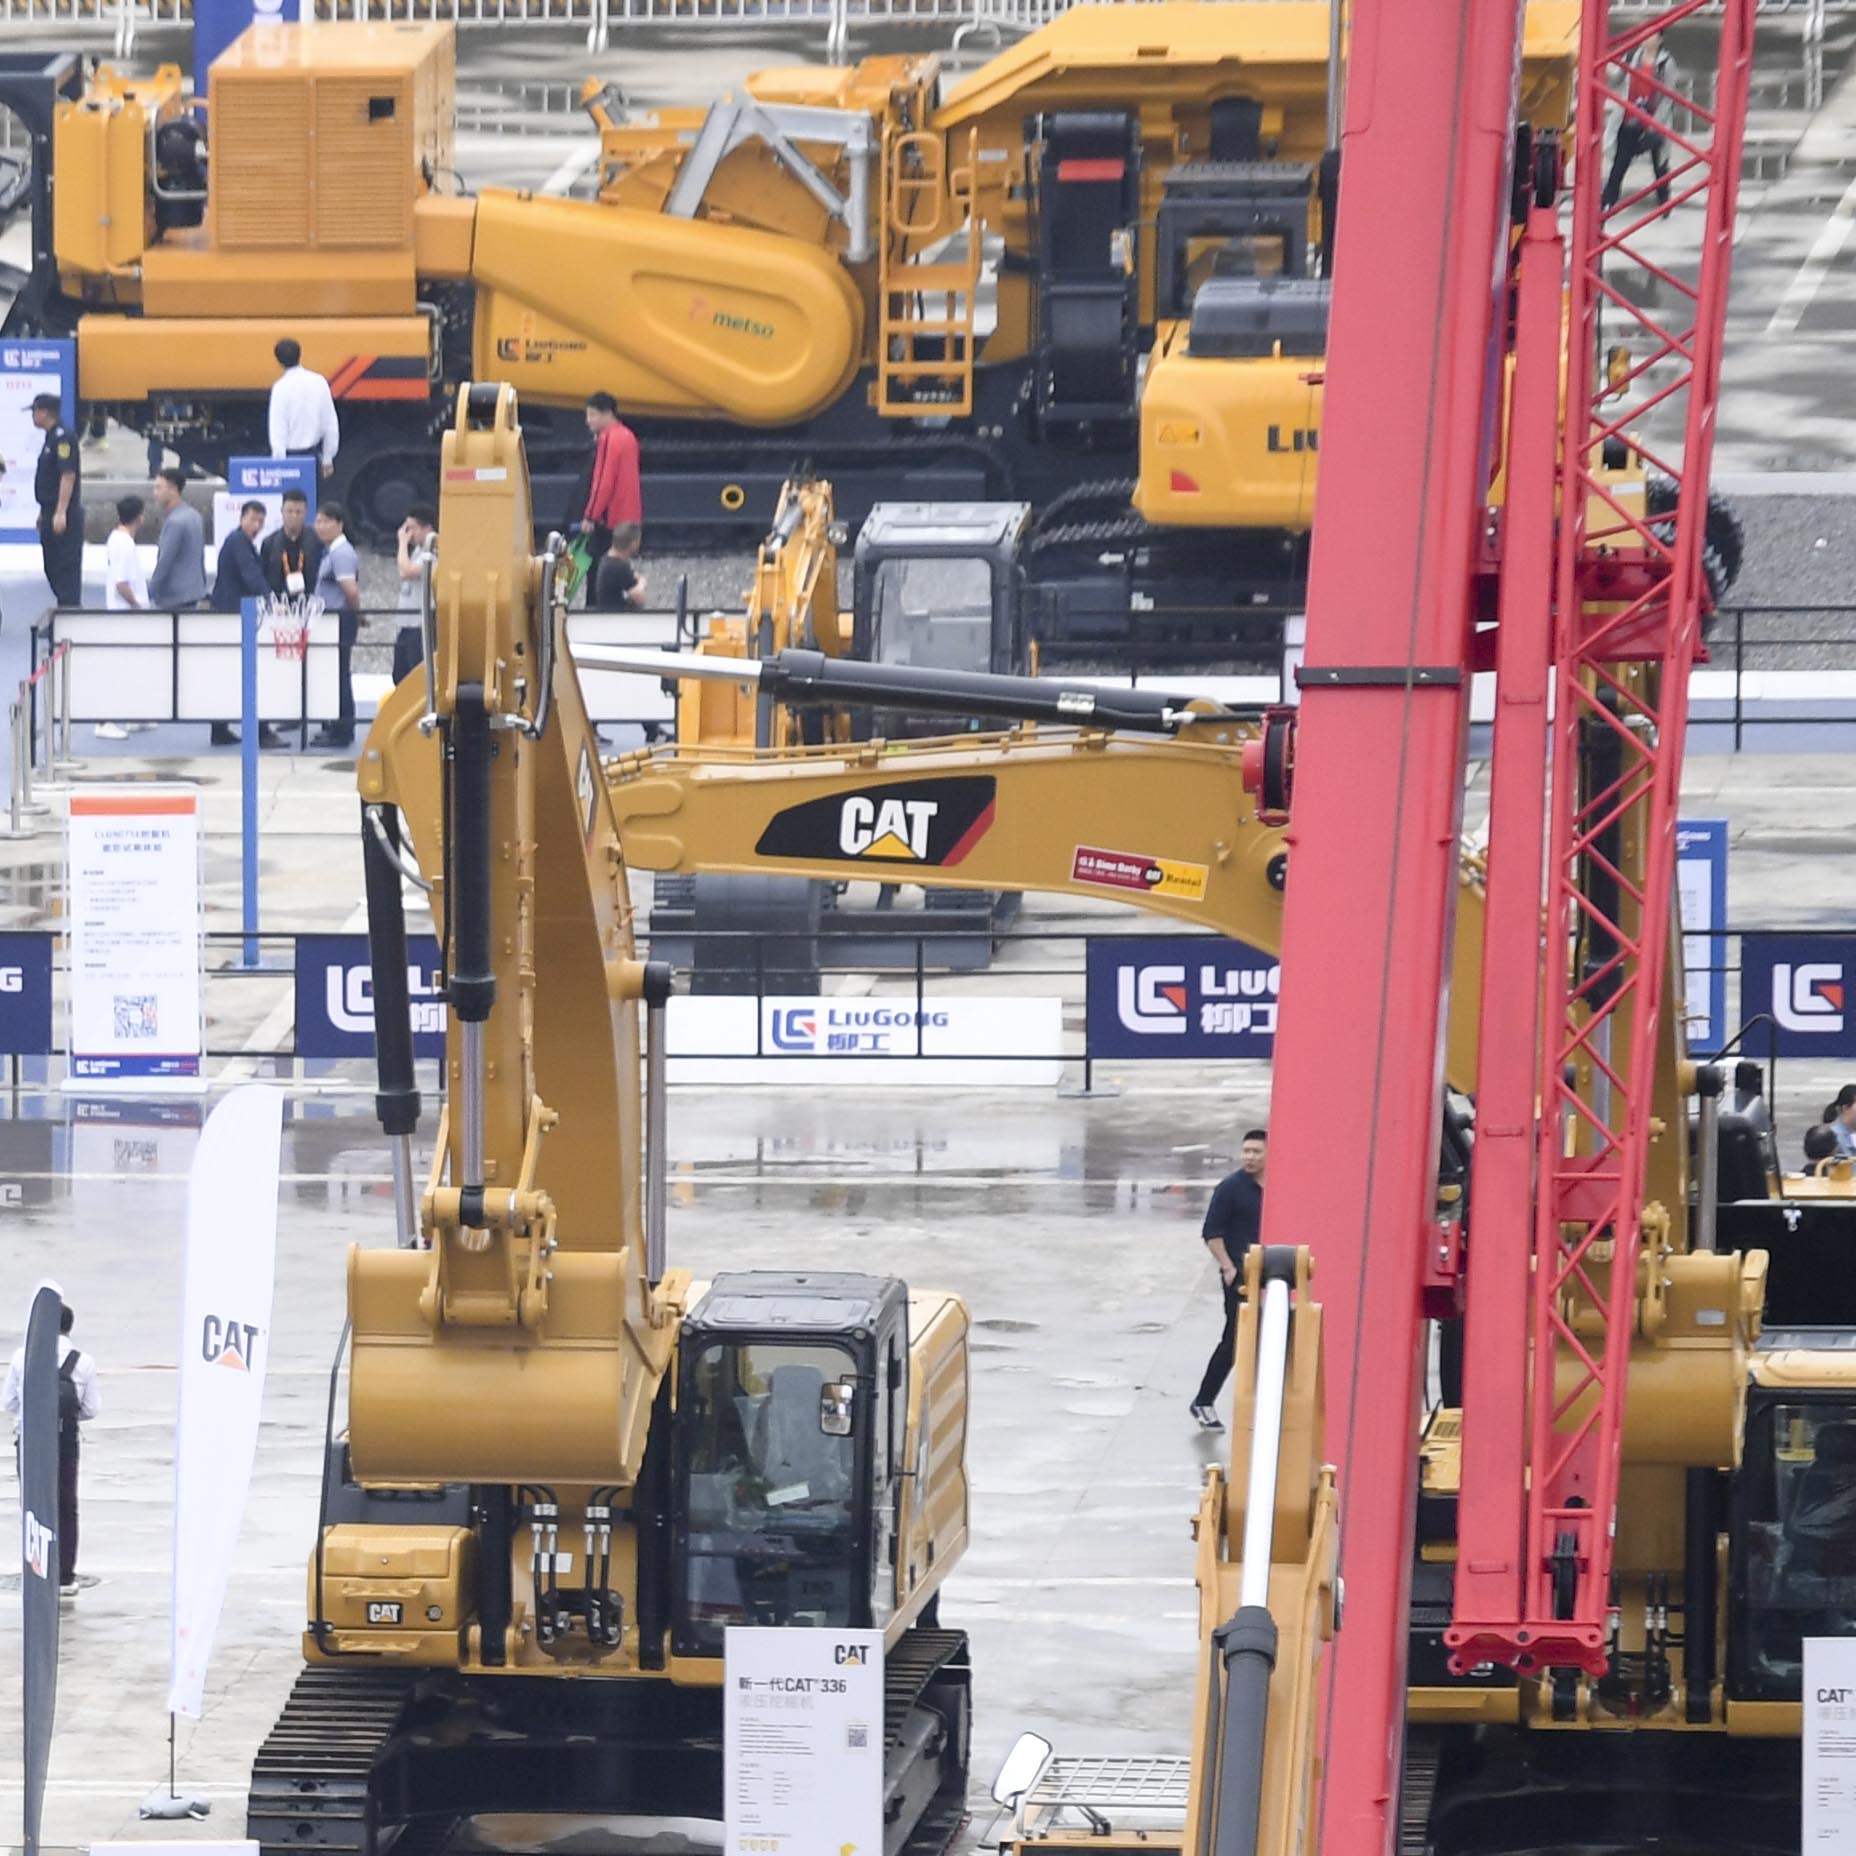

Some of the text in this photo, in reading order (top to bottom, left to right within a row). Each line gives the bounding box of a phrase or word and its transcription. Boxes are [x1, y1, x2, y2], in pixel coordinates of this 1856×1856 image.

[712, 311, 774, 338] metso
[839, 796, 937, 857] CAT
[827, 1030, 891, 1052] 柳工
[203, 1315, 260, 1372] CAT
[369, 1601, 401, 1624] CAT
[835, 1644, 869, 1665] CAT
[820, 1679, 847, 1693] 336
